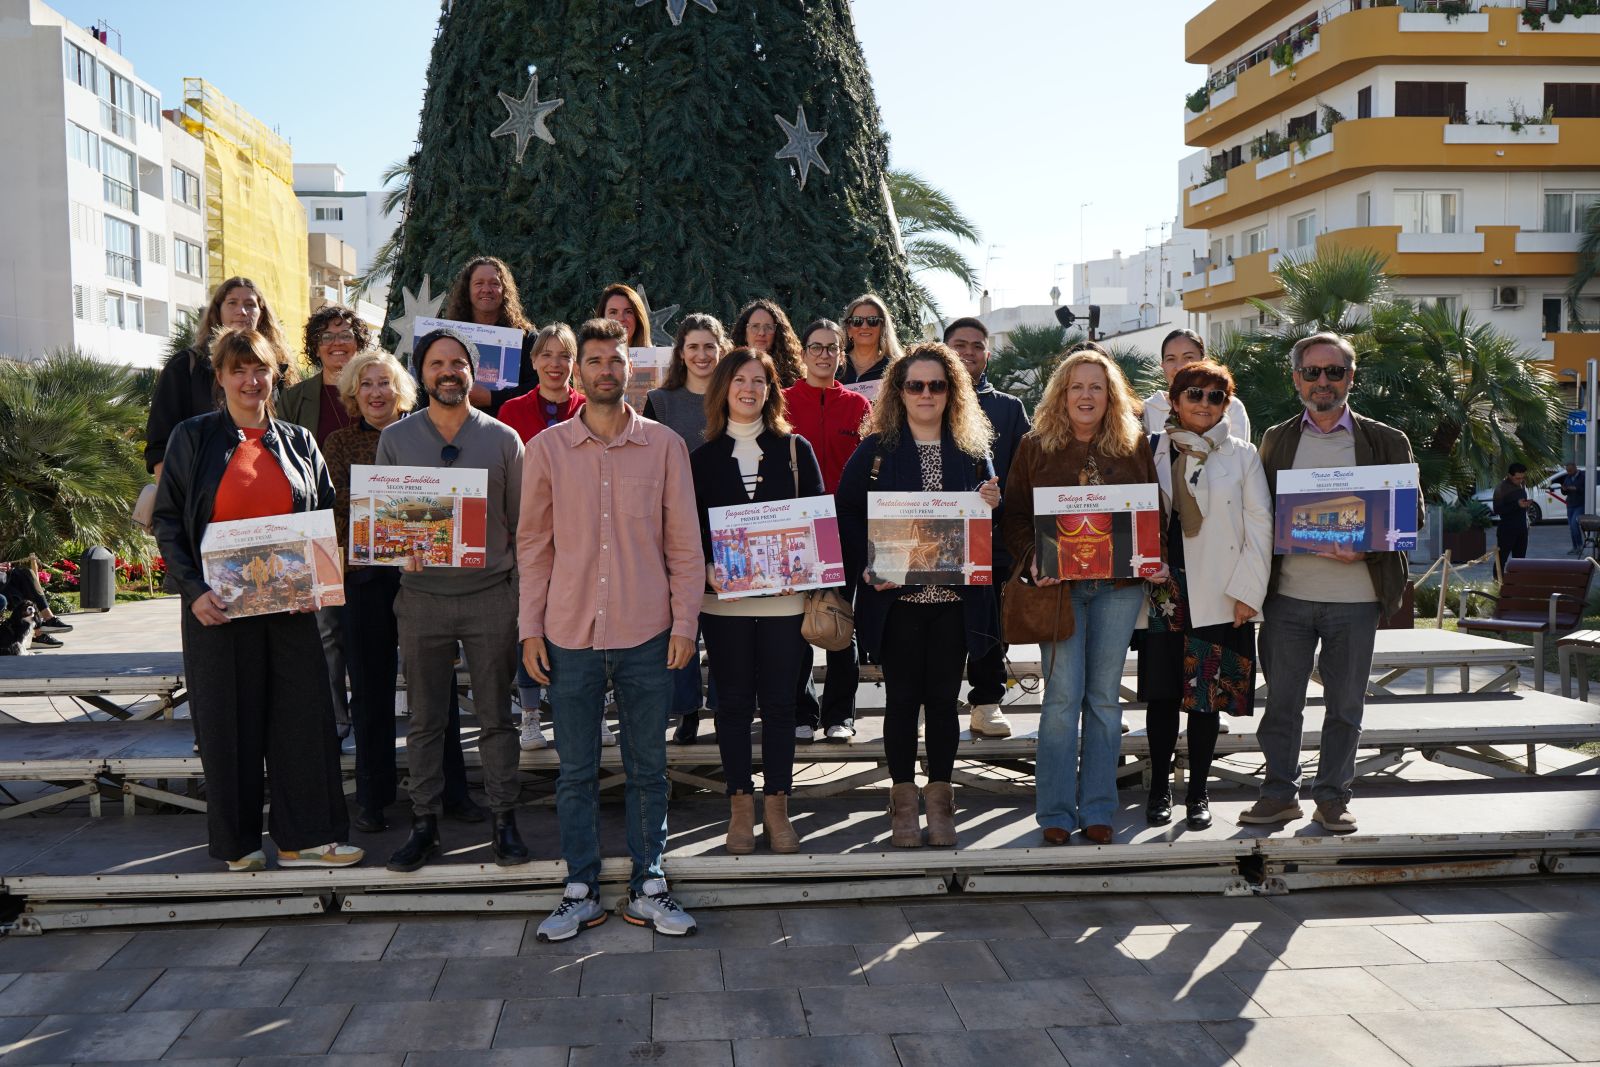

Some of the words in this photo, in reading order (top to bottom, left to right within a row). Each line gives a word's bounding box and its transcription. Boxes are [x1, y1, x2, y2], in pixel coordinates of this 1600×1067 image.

[1567, 418, 1587, 426] TAX
[368, 474, 400, 485] Antigua
[931, 498, 958, 507] Mercat
[1058, 494, 1083, 503] Bodega
[1086, 493, 1107, 502] Ribas
[762, 504, 791, 514] Divertit
[265, 524, 288, 534] Flores
[464, 557, 481, 565] 2025
[825, 572, 841, 580] 2025
